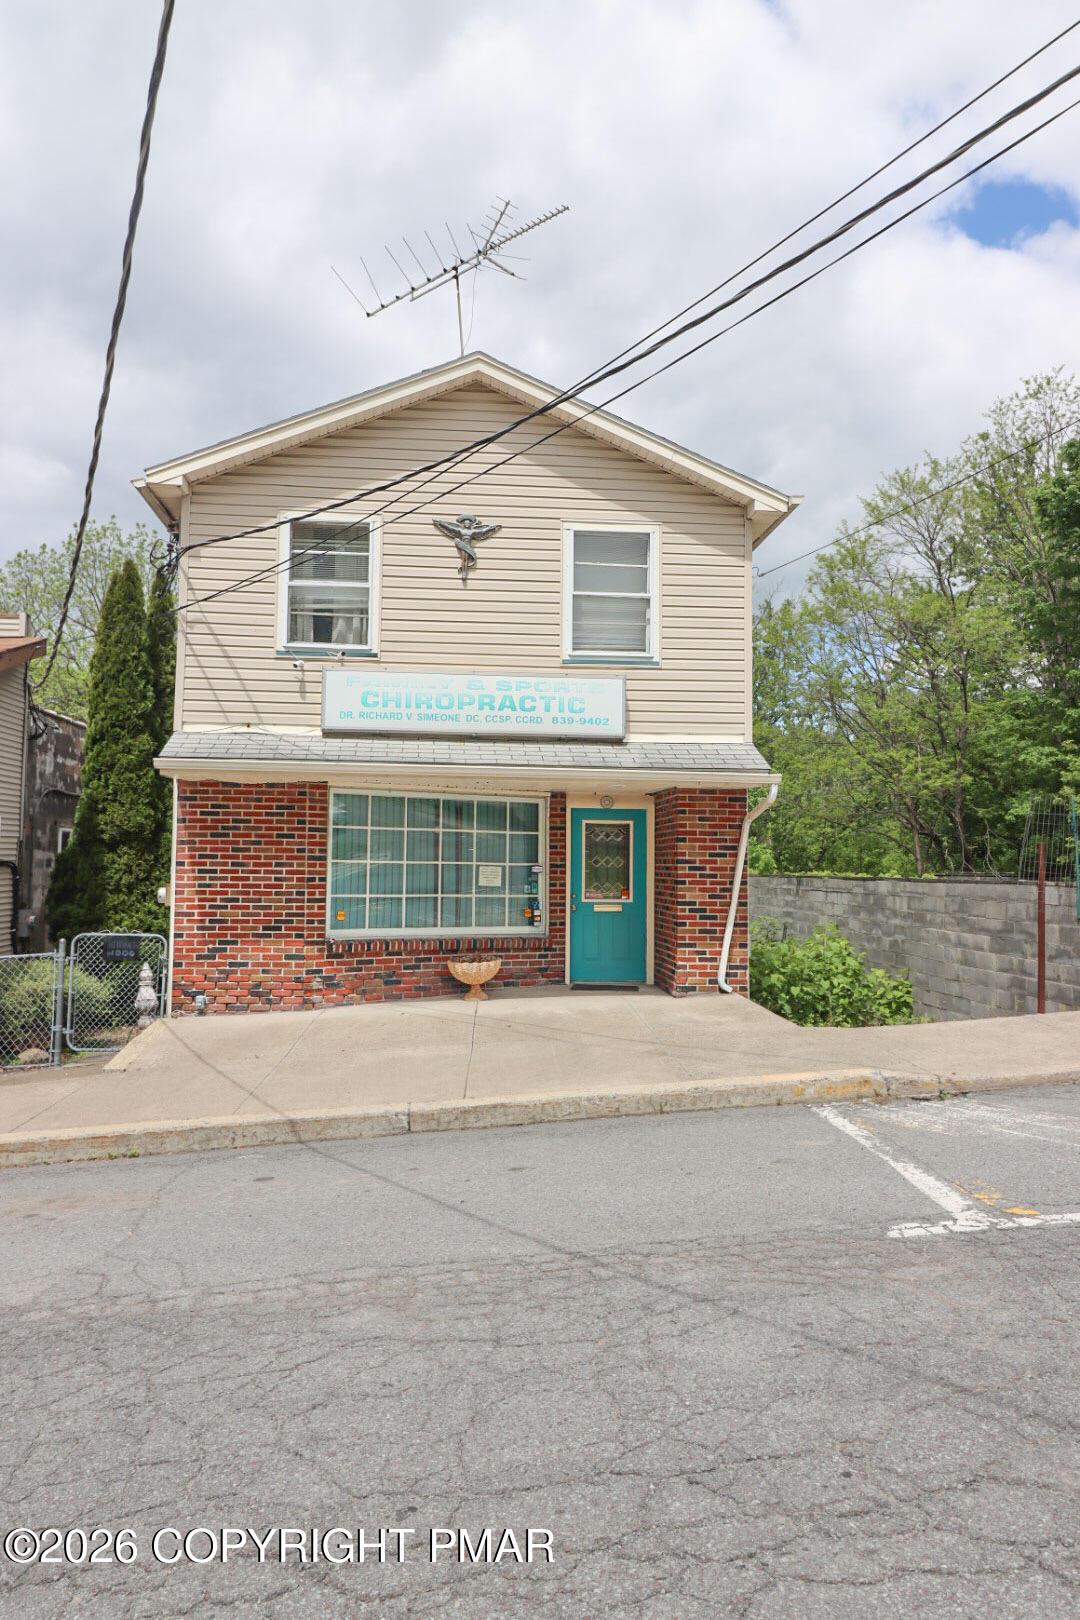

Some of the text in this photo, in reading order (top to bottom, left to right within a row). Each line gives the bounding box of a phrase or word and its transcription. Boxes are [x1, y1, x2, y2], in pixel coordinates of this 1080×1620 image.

[360, 690, 586, 714] CHIROPRACTIC
[358, 711, 404, 721] RICHARD
[417, 713, 461, 722] SIMEONE
[551, 717, 610, 726] 839-9402
